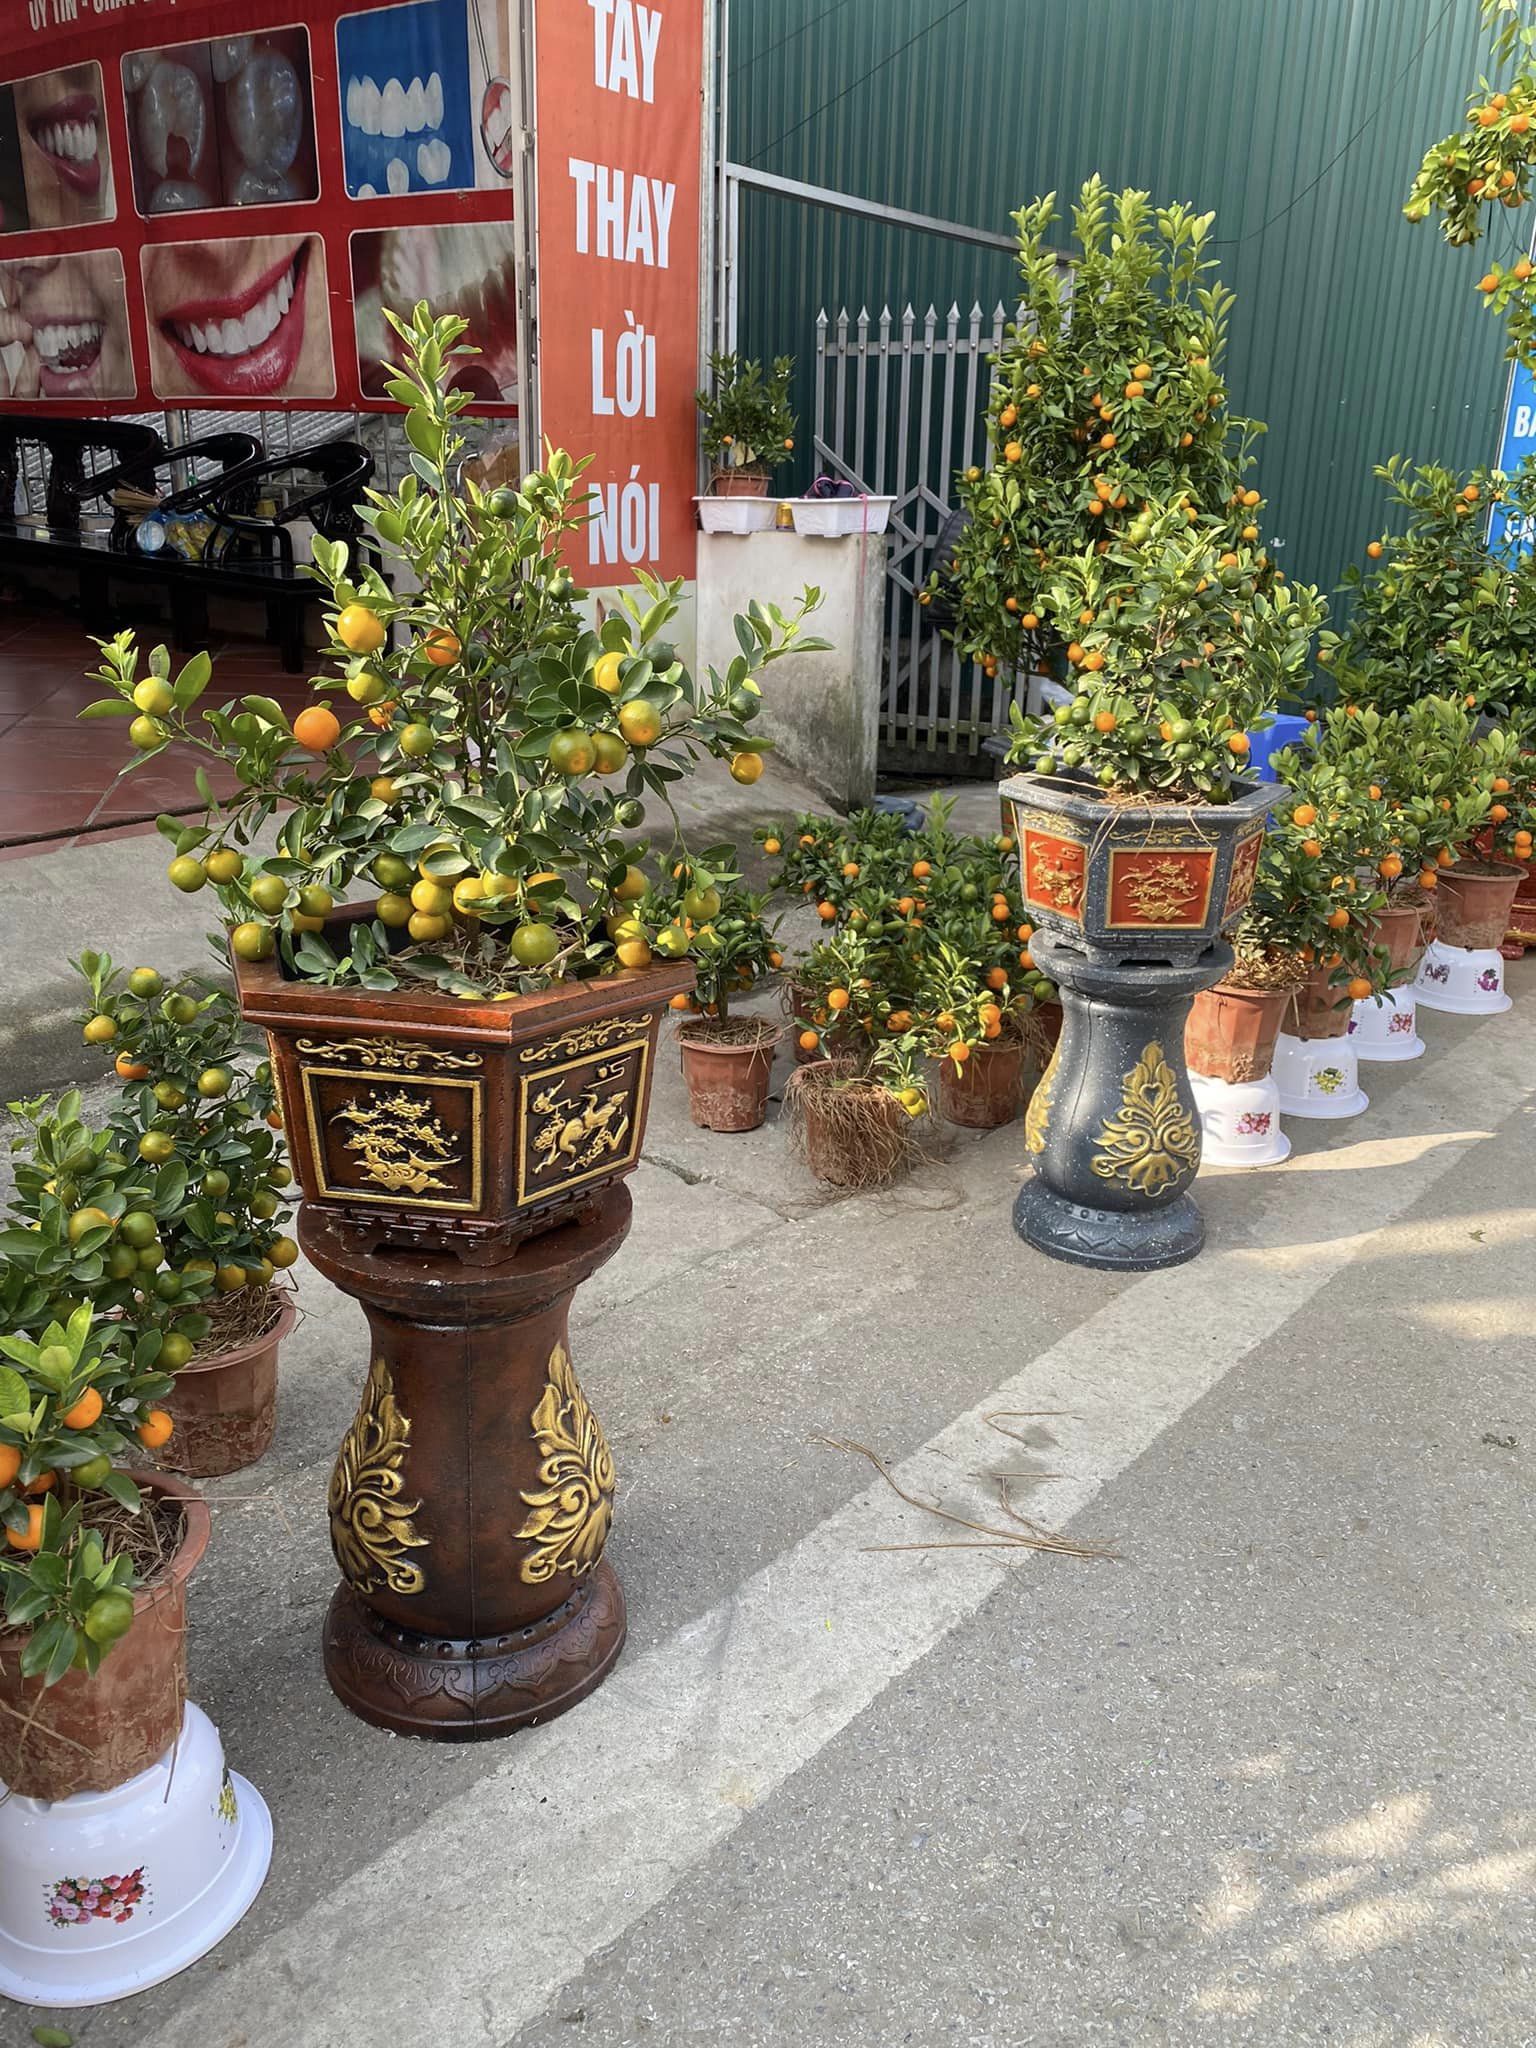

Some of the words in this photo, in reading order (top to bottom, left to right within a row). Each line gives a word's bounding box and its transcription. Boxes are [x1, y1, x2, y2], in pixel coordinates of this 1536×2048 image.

[587, 0, 663, 104] TAY
[568, 157, 676, 269] THAY
[591, 309, 656, 418] LỜI
[588, 464, 660, 565] NÓI
